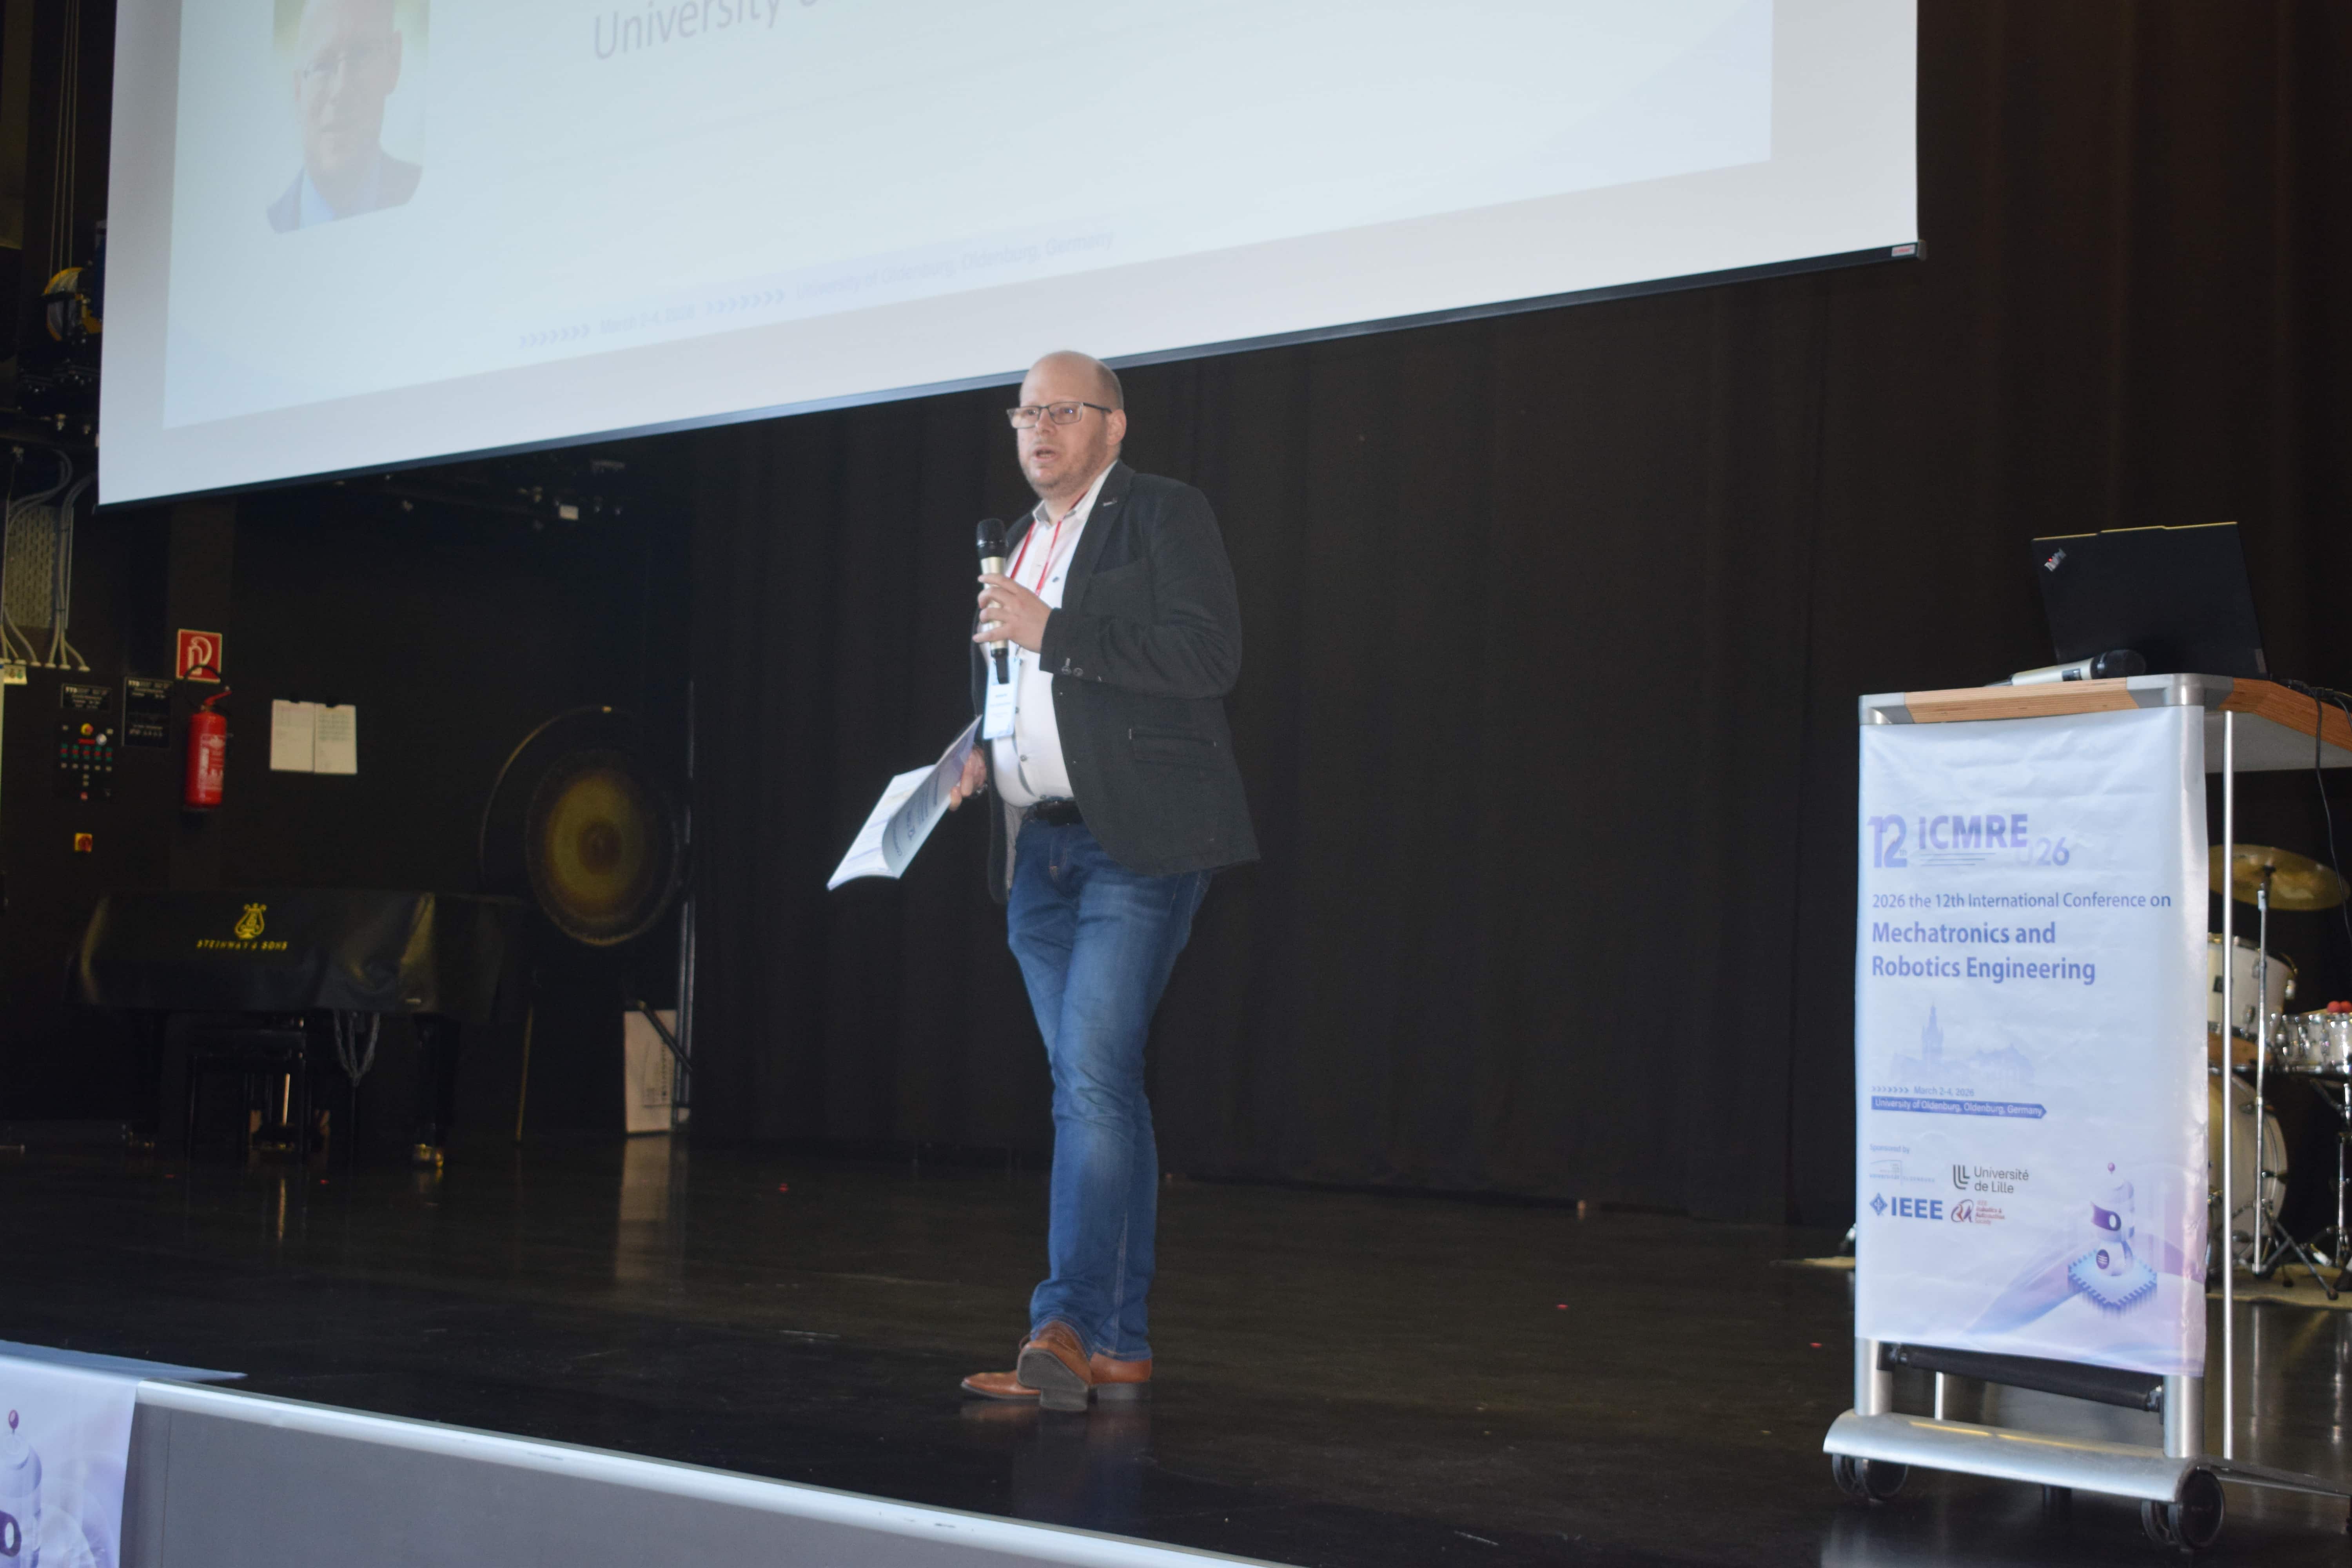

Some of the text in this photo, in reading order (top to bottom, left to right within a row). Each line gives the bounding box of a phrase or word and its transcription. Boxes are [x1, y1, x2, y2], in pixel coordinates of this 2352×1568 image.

[1872, 892, 2171, 908] 2026 the 12th International Conference on
[1872, 921, 2055, 943] Mechatronics and
[1872, 955, 2096, 985] Robotics Engineering
[1913, 1086, 1938, 1095] March
[1875, 1098, 1911, 1109] University
[2007, 1104, 2042, 1116] Germany
[1974, 1166, 2029, 1181] Université
[1975, 1181, 2014, 1194] de Lille
[1891, 1196, 1943, 1220] IEEE
